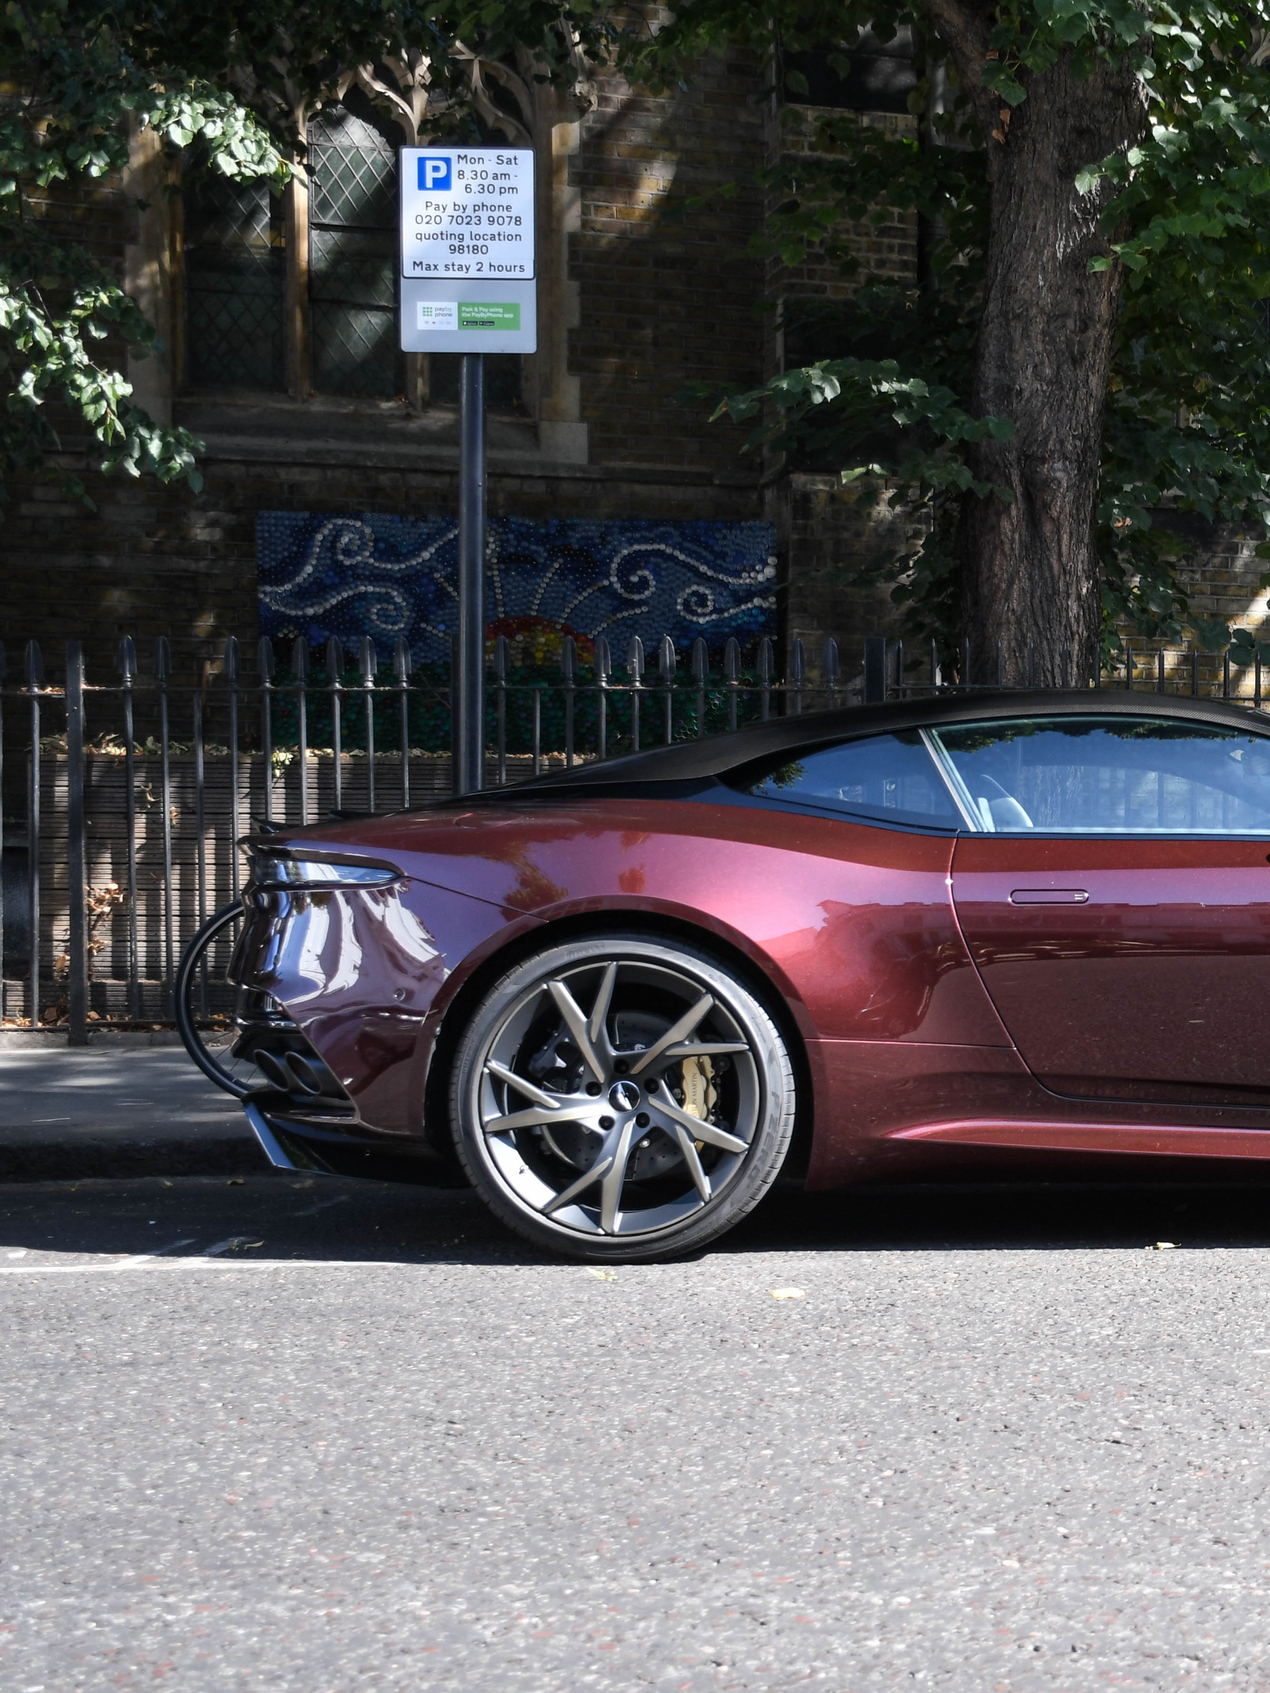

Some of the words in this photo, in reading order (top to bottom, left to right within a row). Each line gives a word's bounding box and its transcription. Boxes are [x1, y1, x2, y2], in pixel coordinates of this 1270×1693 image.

[457, 154, 485, 165] Mon
[496, 154, 519, 166] Sat
[425, 160, 447, 188] P
[457, 170, 489, 181] 8.30
[492, 172, 511, 181] am
[464, 183, 496, 194] 6.30
[499, 186, 519, 197] pm
[425, 201, 448, 214] Pay
[453, 201, 468, 214] by
[473, 201, 513, 214] phone
[415, 214, 443, 225] 020
[447, 214, 482, 226] 7023
[487, 215, 522, 227] 9078
[415, 230, 465, 243] quoting
[469, 230, 522, 242] location
[448, 244, 489, 255] 98180
[412, 260, 439, 272] Max
[444, 261, 471, 274] stay
[475, 261, 484, 272] 2
[488, 261, 525, 273] hours
